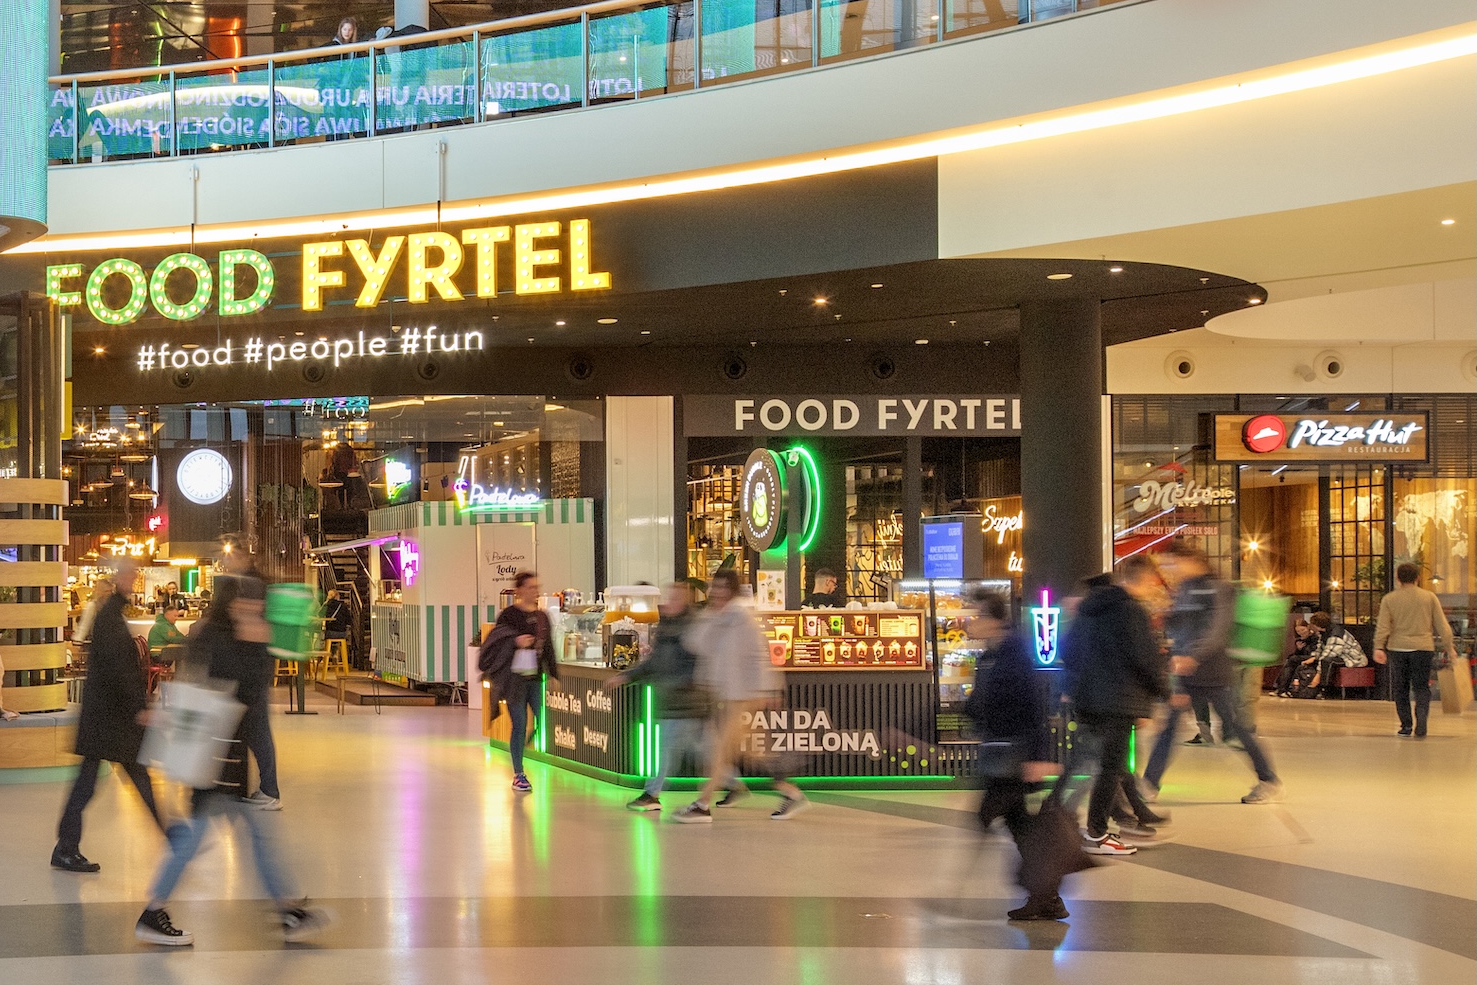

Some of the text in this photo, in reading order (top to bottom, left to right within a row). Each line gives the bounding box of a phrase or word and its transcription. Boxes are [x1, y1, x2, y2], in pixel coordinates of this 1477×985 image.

[46, 218, 613, 325] FOOD FYRTEL
[136, 325, 485, 371] #food #people #fun
[734, 399, 861, 431] FOOD
[1288, 418, 1423, 449] Pizza Hut
[496, 565, 517, 576] Lody
[546, 690, 582, 714] Bubble Tea
[586, 689, 612, 712] Coffee
[793, 710, 831, 730] DA
[554, 726, 576, 748] Shake
[584, 725, 608, 753] Desery
[770, 732, 880, 757] ZIELONĄ
